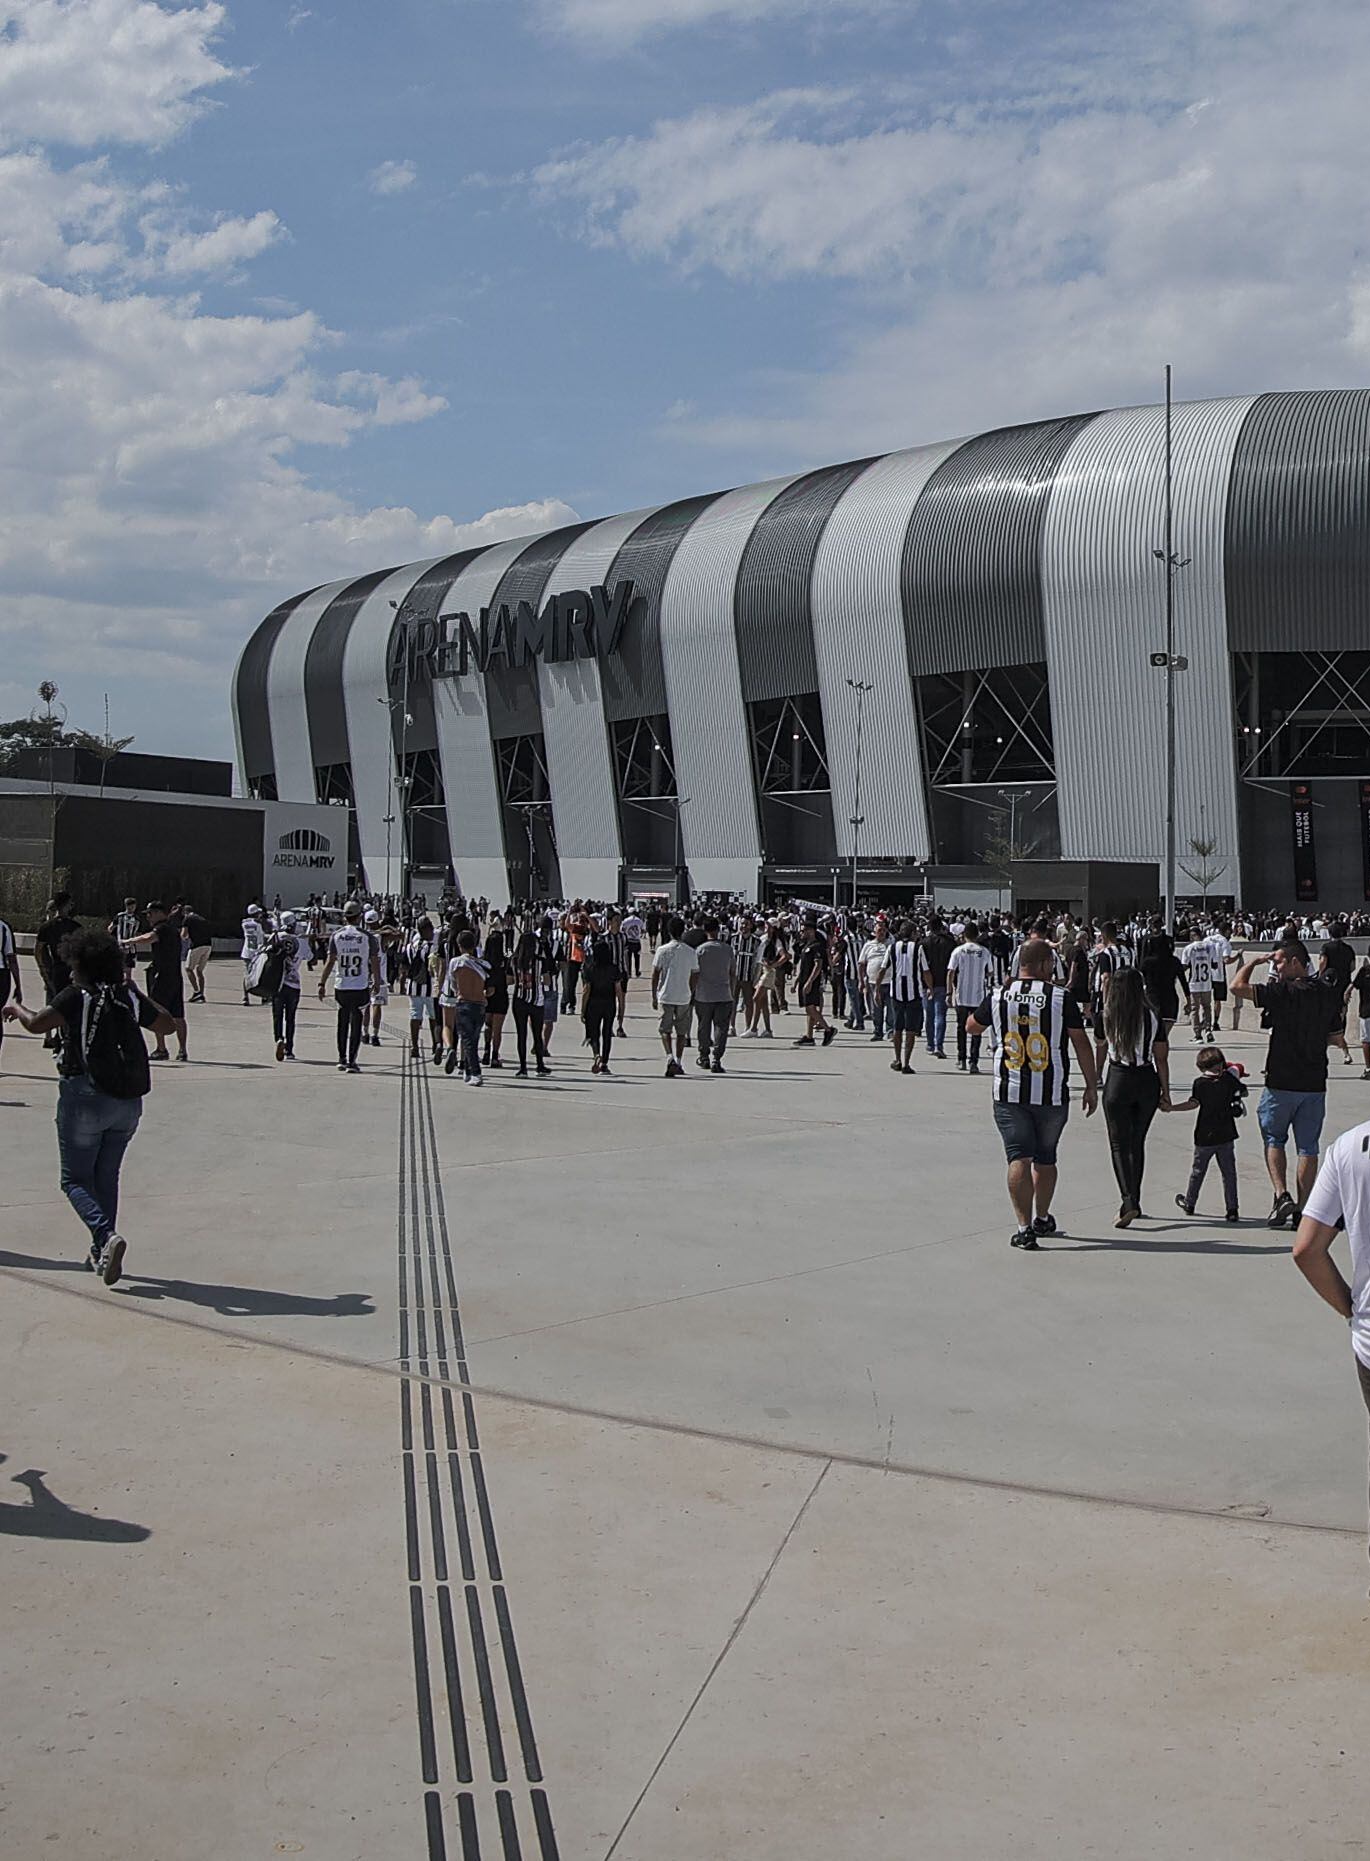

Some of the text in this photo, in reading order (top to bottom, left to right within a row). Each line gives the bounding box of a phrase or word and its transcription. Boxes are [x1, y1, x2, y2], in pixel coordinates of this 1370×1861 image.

[1295, 811, 1303, 827] QUE
[1302, 811, 1310, 844] FUTEBOL
[340, 954, 363, 977] 43
[1194, 962, 1209, 983] 13
[1014, 991, 1046, 1008] bmg
[1004, 1031, 1049, 1072] 99
